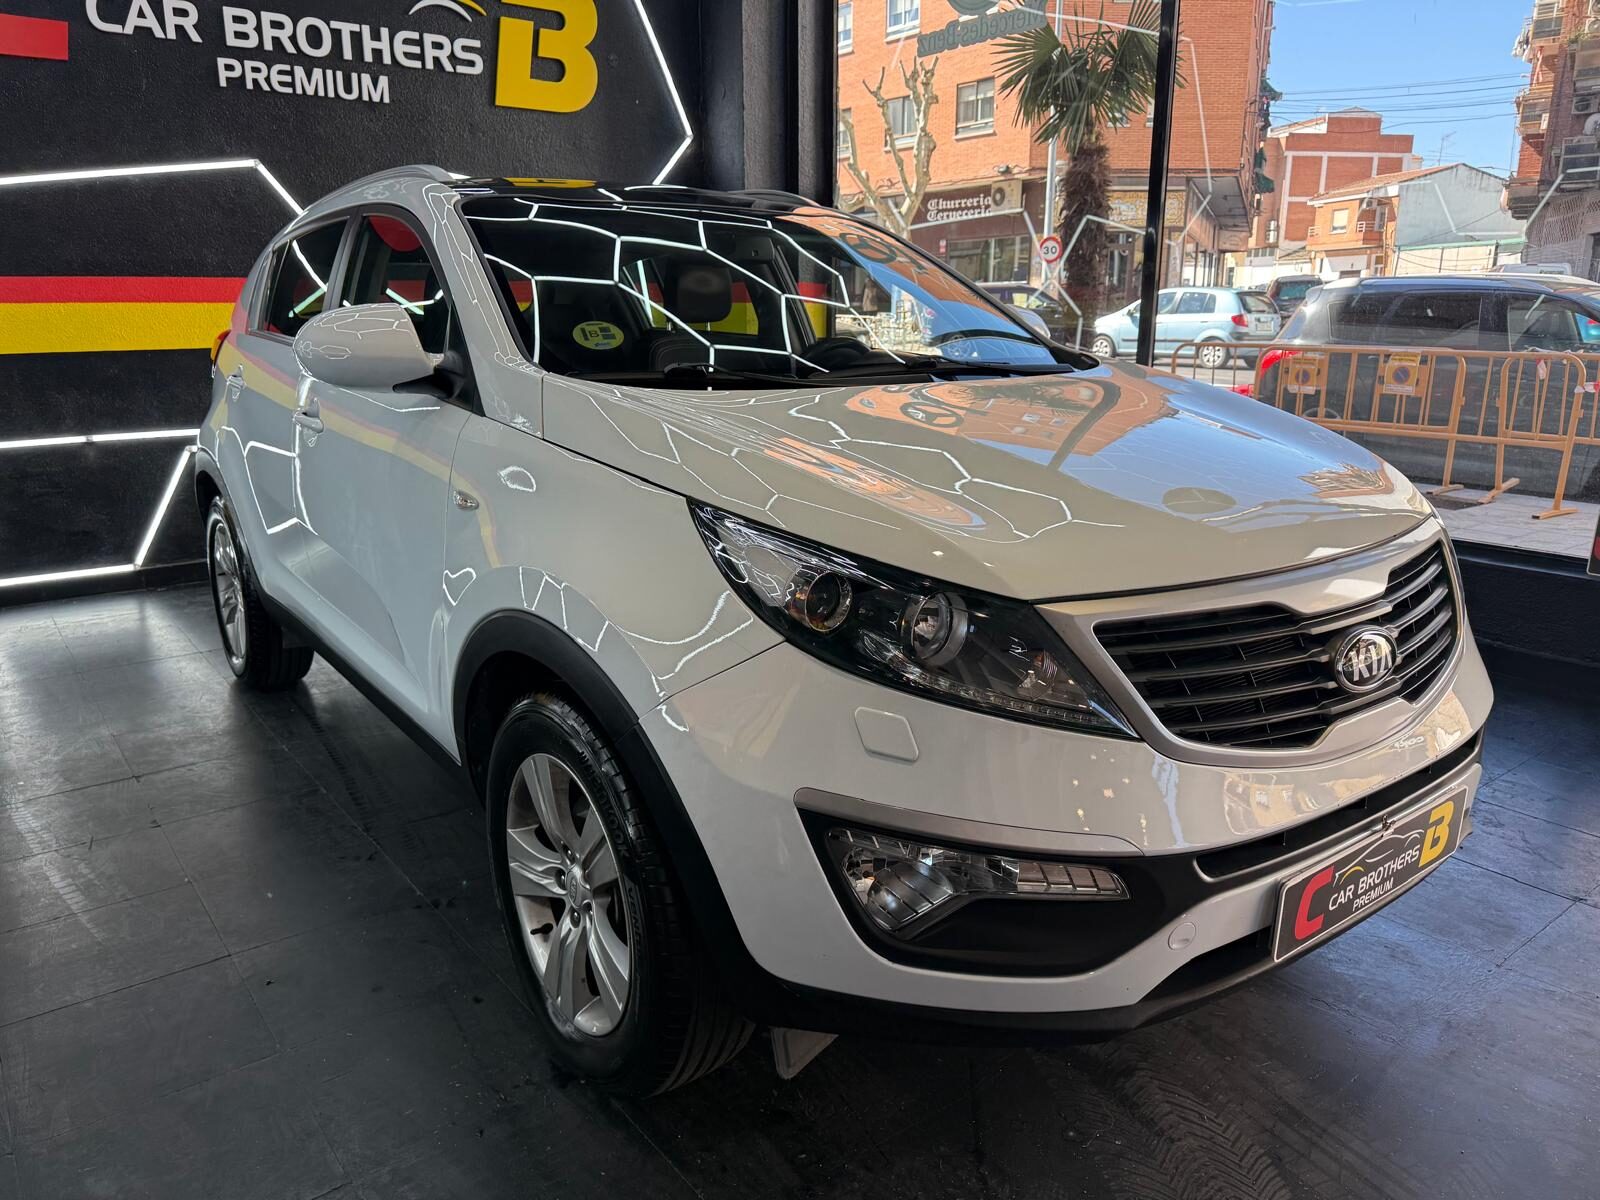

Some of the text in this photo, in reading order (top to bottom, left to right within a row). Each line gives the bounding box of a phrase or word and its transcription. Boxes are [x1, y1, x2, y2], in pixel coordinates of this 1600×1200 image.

[85, 0, 484, 75] CAR BROTHERS
[216, 57, 390, 104] PREMIUM
[1043, 246, 1058, 255] 30
[1350, 641, 1393, 681] KIA
[1418, 800, 1455, 868] B
[1294, 865, 1335, 940] C
[1328, 844, 1421, 911] CAR BROTHERS
[1352, 877, 1394, 912] PREMIUM
